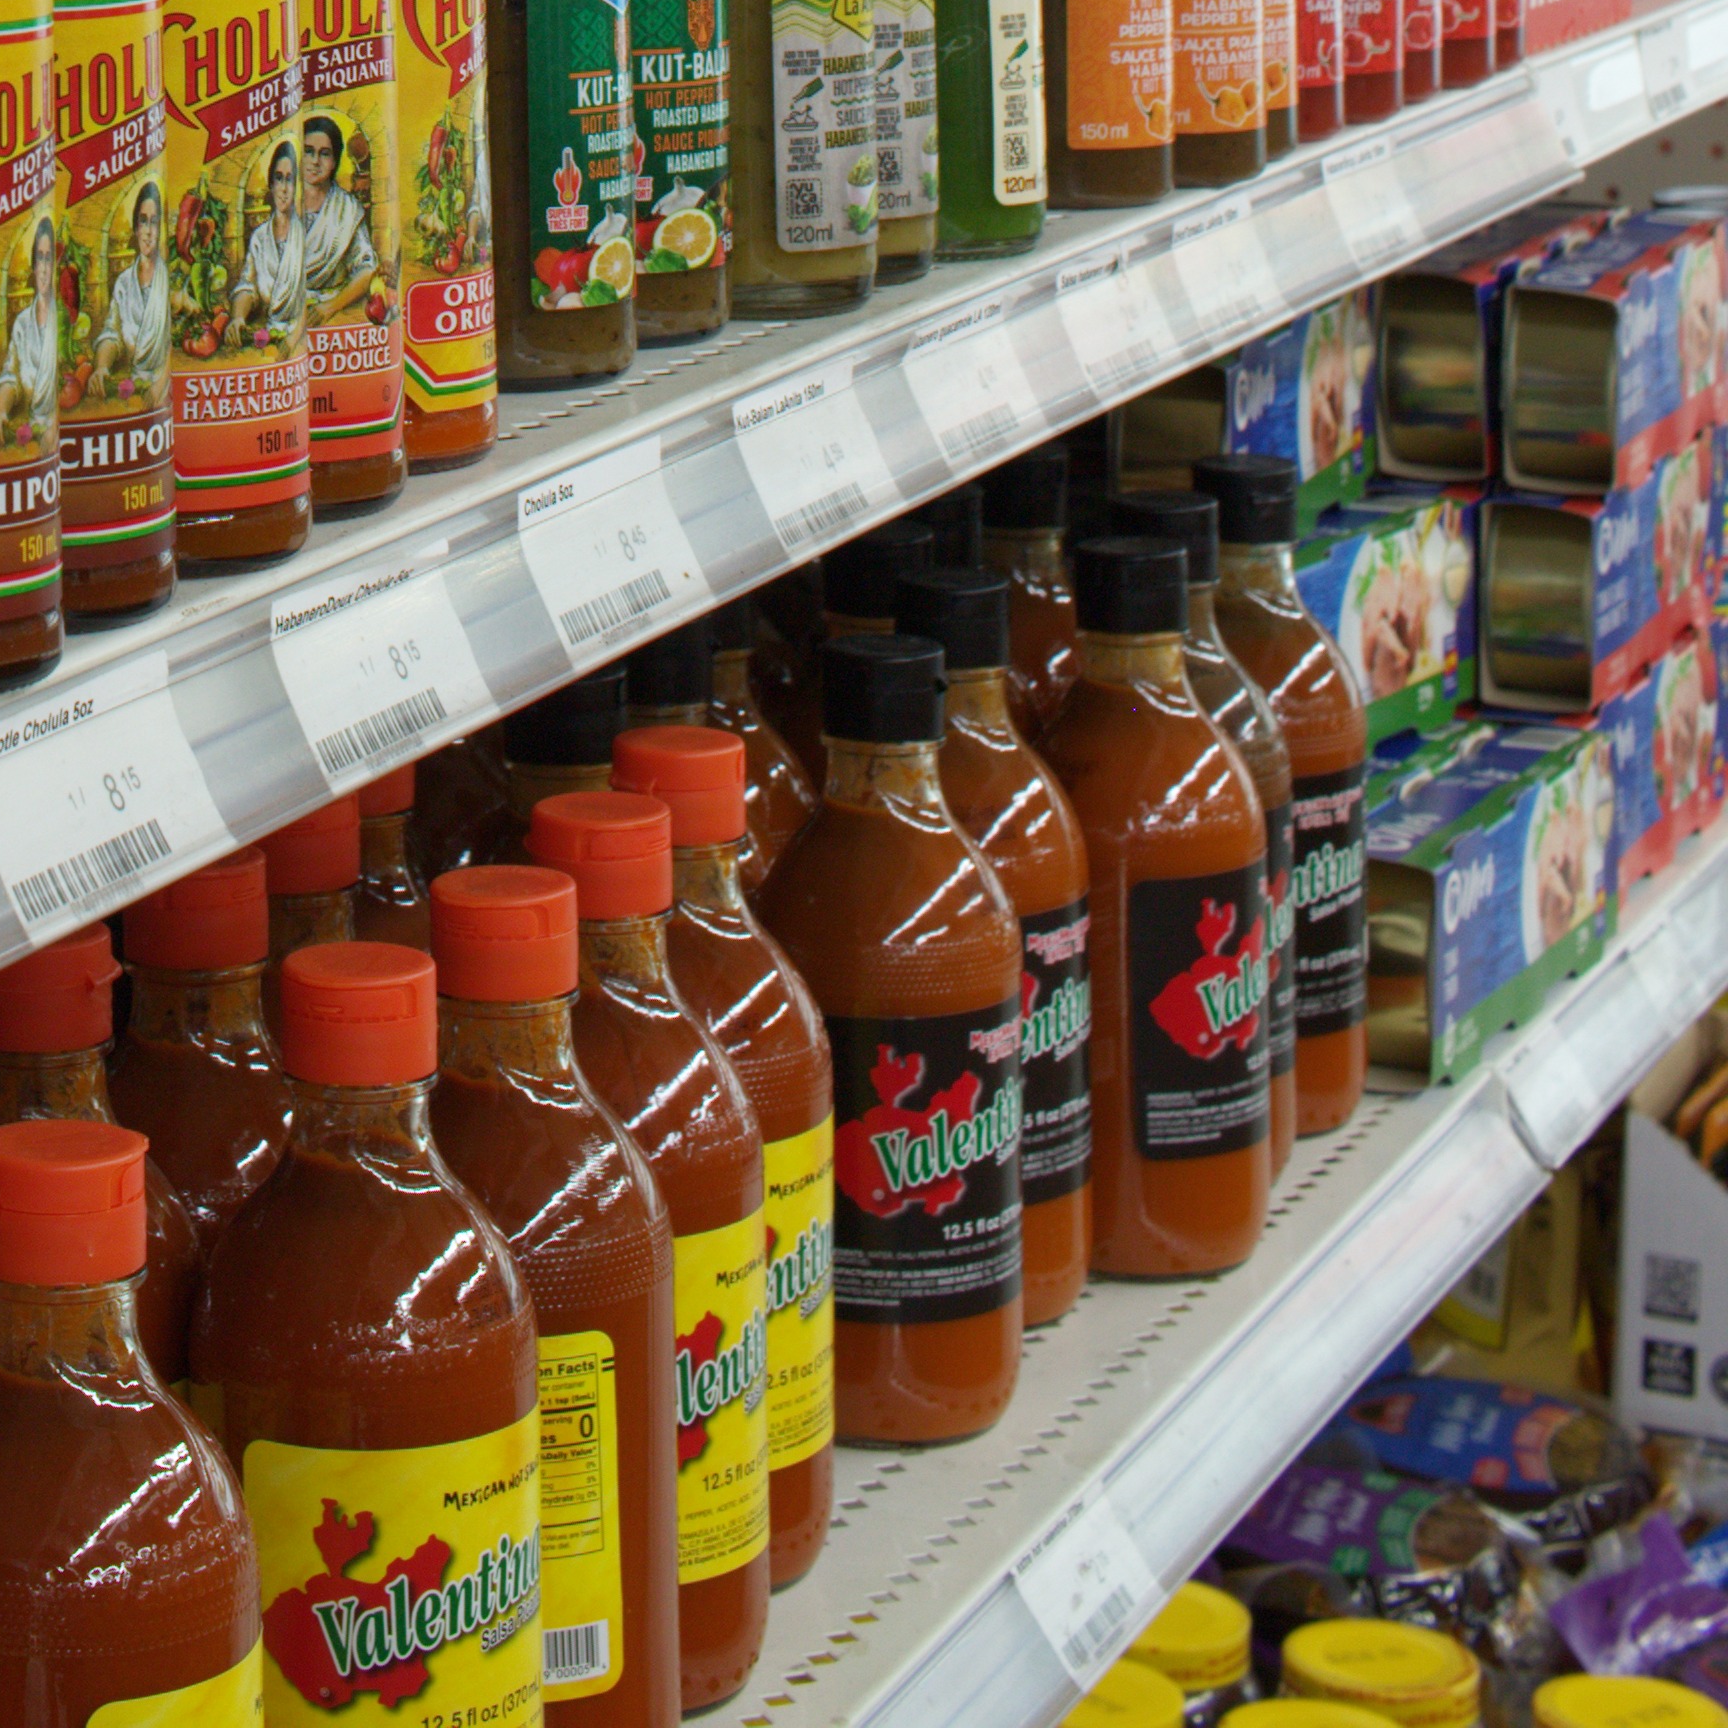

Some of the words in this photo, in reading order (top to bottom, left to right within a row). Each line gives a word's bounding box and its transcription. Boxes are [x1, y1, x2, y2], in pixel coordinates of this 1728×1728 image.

[319, 42, 374, 69] SAUCE
[313, 60, 390, 91] PIQUANTE
[645, 91, 671, 110] HOT
[653, 107, 698, 128] ROASTED
[655, 133, 693, 151] SAUCE
[1080, 126, 1108, 140] 150
[786, 225, 833, 243] 120ml
[331, 346, 391, 372] DOUCE
[185, 373, 257, 397] SWEET
[122, 487, 145, 509] 150
[149, 482, 165, 504] mL
[524, 489, 557, 517] Cholula
[558, 483, 574, 501] 5oz
[23, 709, 69, 742] Cholula
[73, 697, 94, 720] 5oz
[554, 1359, 594, 1376] Facts
